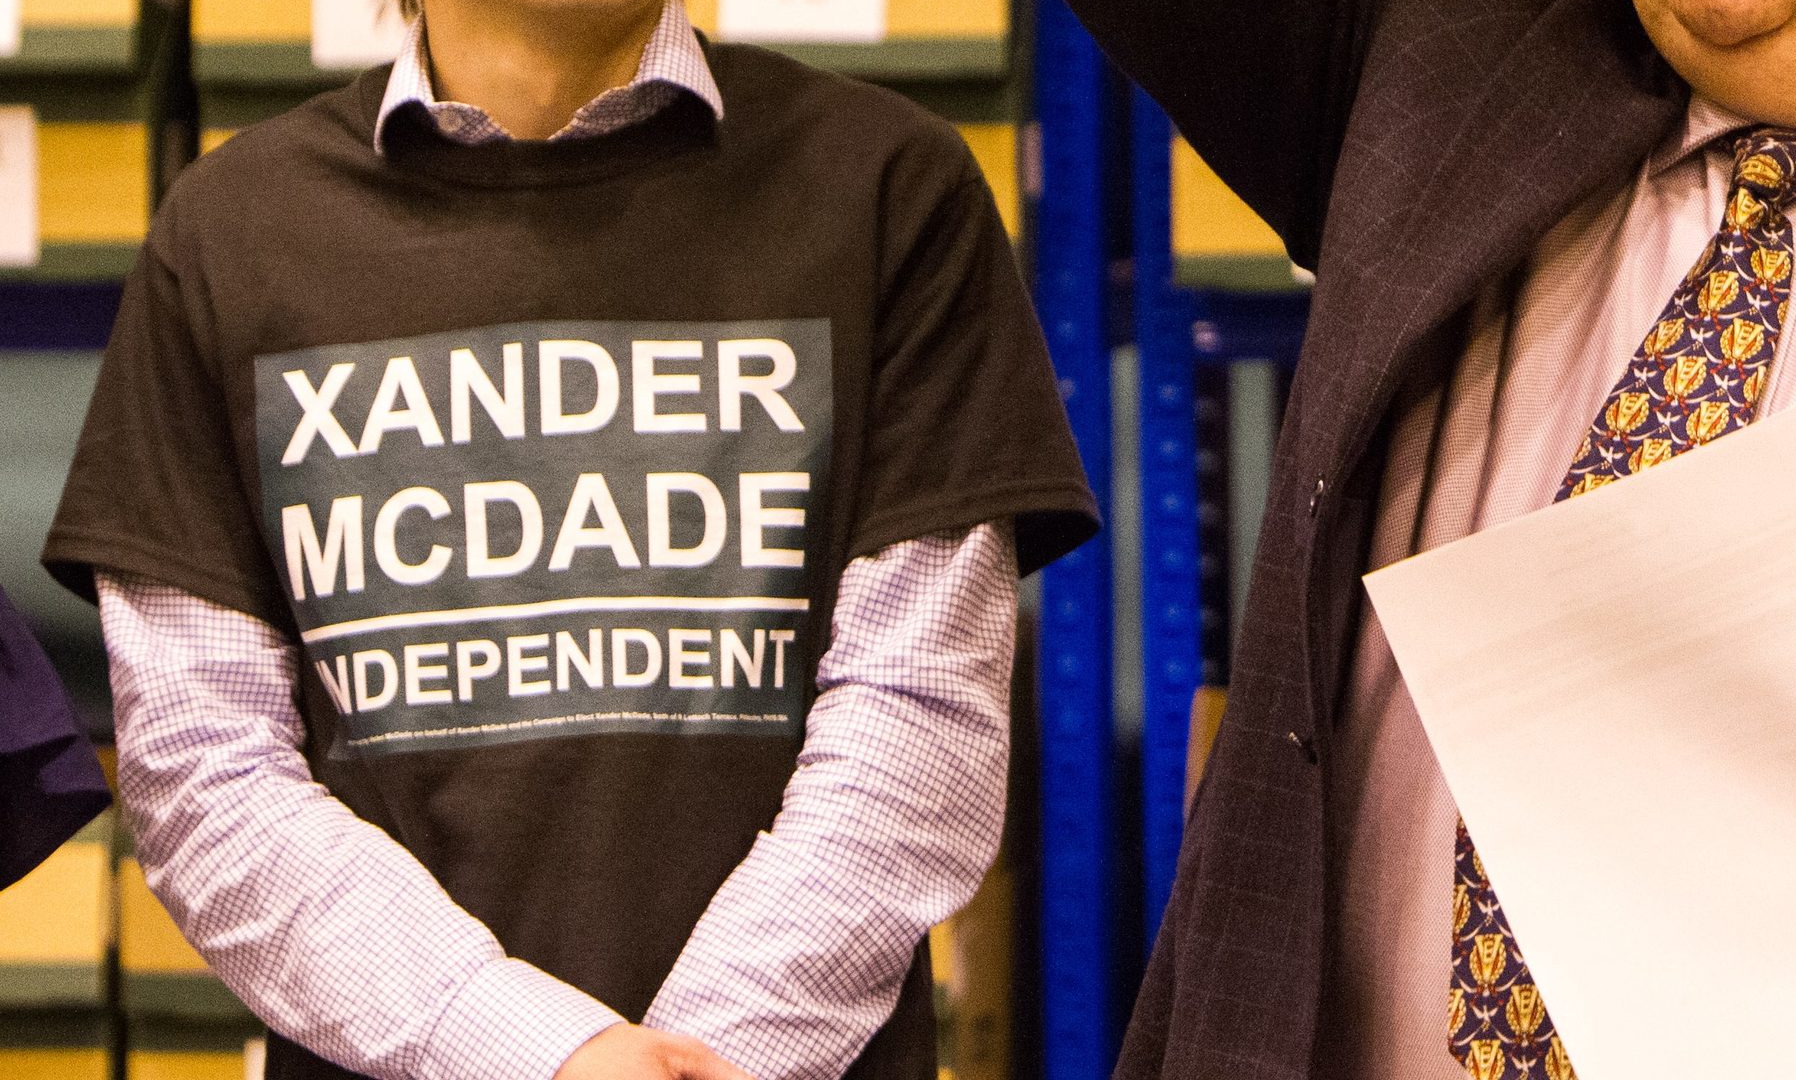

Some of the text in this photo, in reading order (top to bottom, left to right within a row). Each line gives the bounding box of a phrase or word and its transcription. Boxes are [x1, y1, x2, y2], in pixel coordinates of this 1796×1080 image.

[280, 337, 805, 466] XANDER
[281, 471, 811, 601] MCDADE
[314, 628, 796, 716] NDEPENDENT
